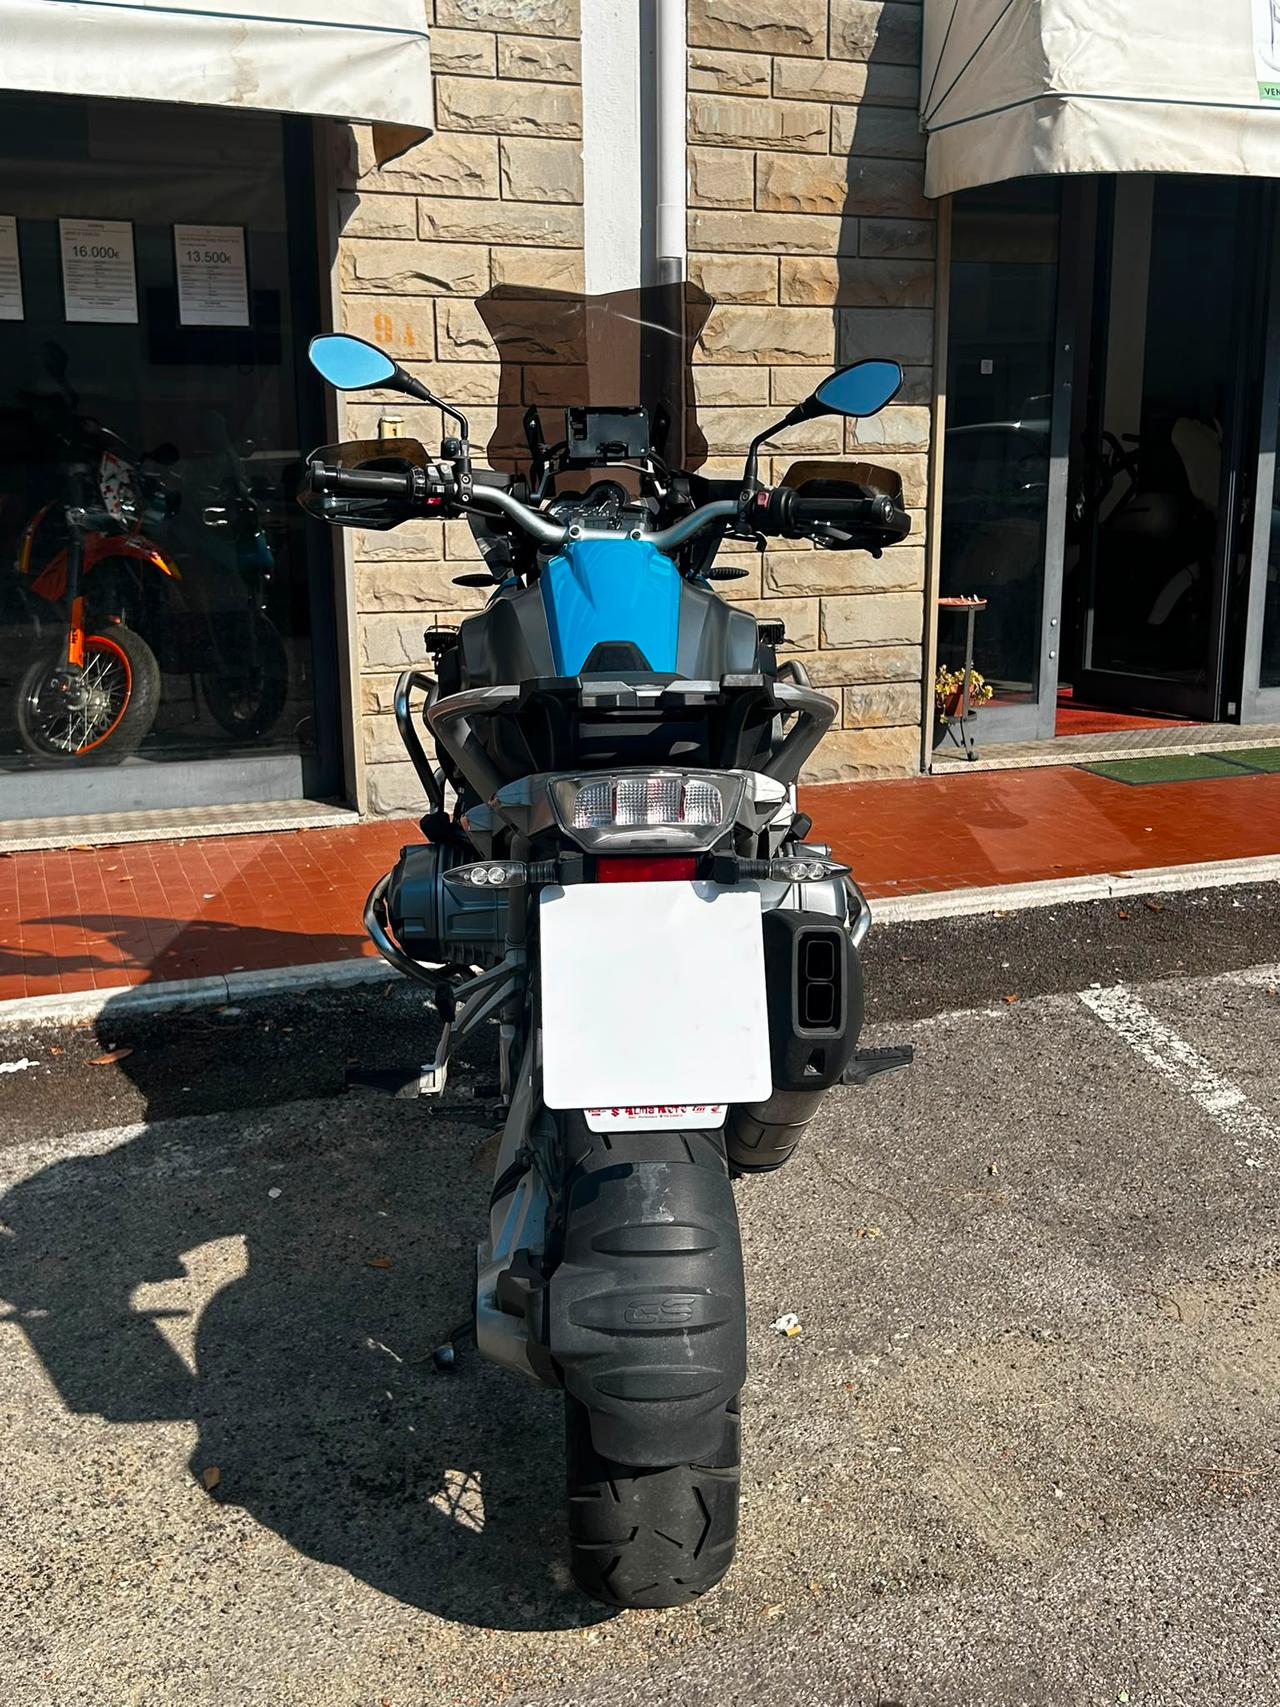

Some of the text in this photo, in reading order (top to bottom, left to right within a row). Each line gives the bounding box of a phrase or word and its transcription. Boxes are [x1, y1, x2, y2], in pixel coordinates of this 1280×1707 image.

[72, 245, 120, 259] 16.000€
[186, 250, 232, 264] 13.500€
[623, 1297, 696, 1325] GS
